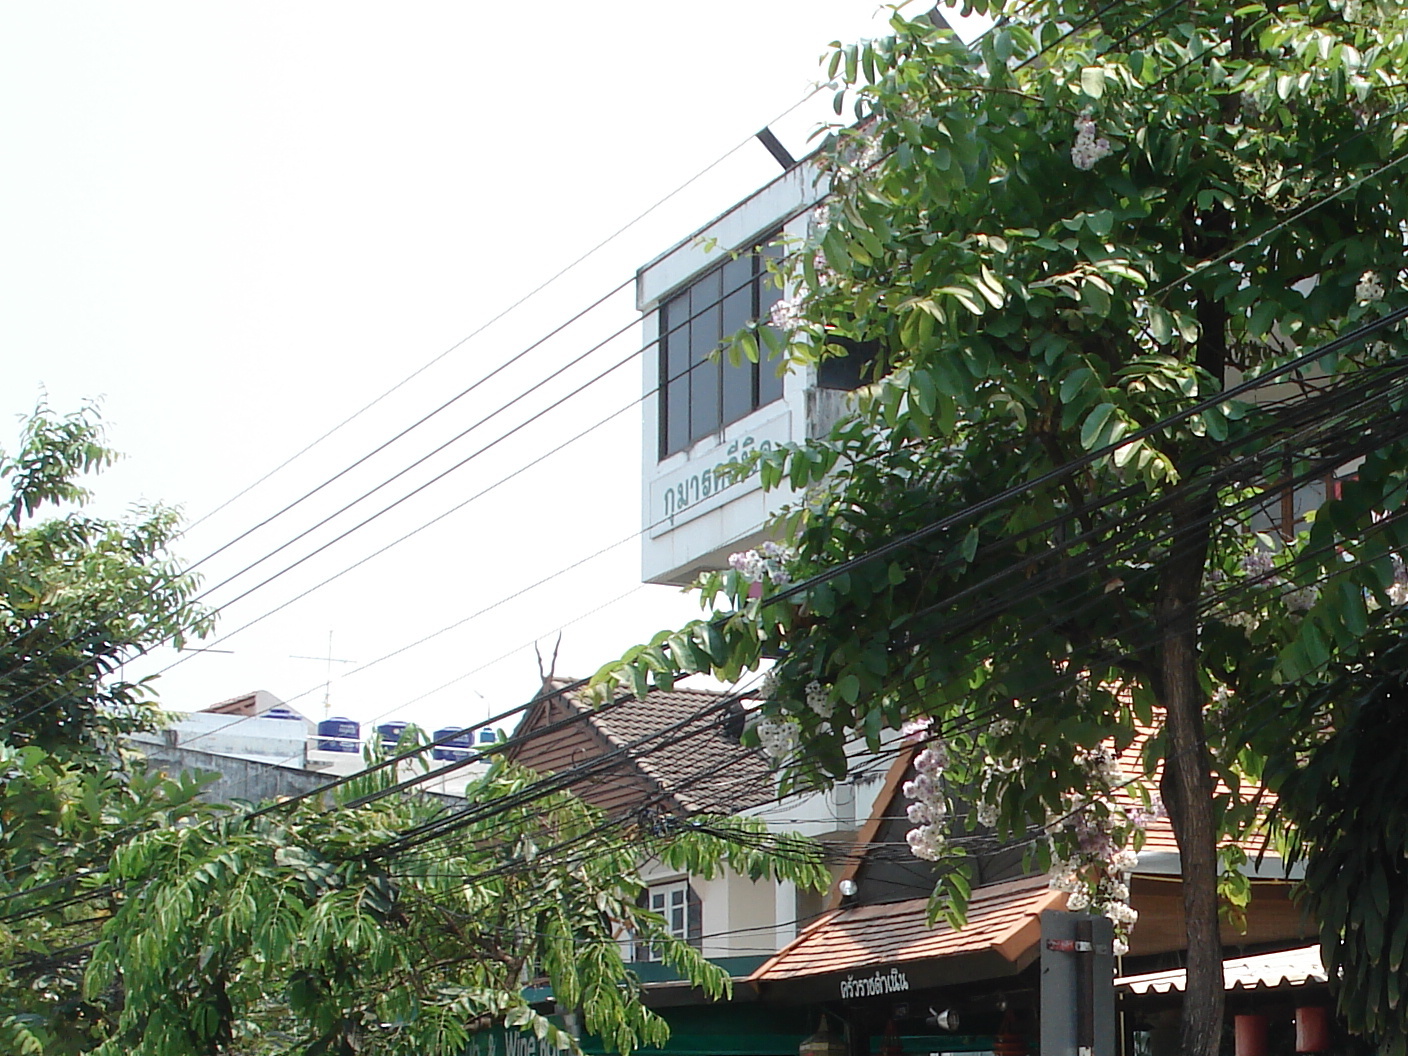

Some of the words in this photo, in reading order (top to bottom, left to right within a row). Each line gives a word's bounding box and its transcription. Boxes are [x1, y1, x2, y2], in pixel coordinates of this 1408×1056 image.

[840, 967, 909, 999] ครัวราชดำเนิน
